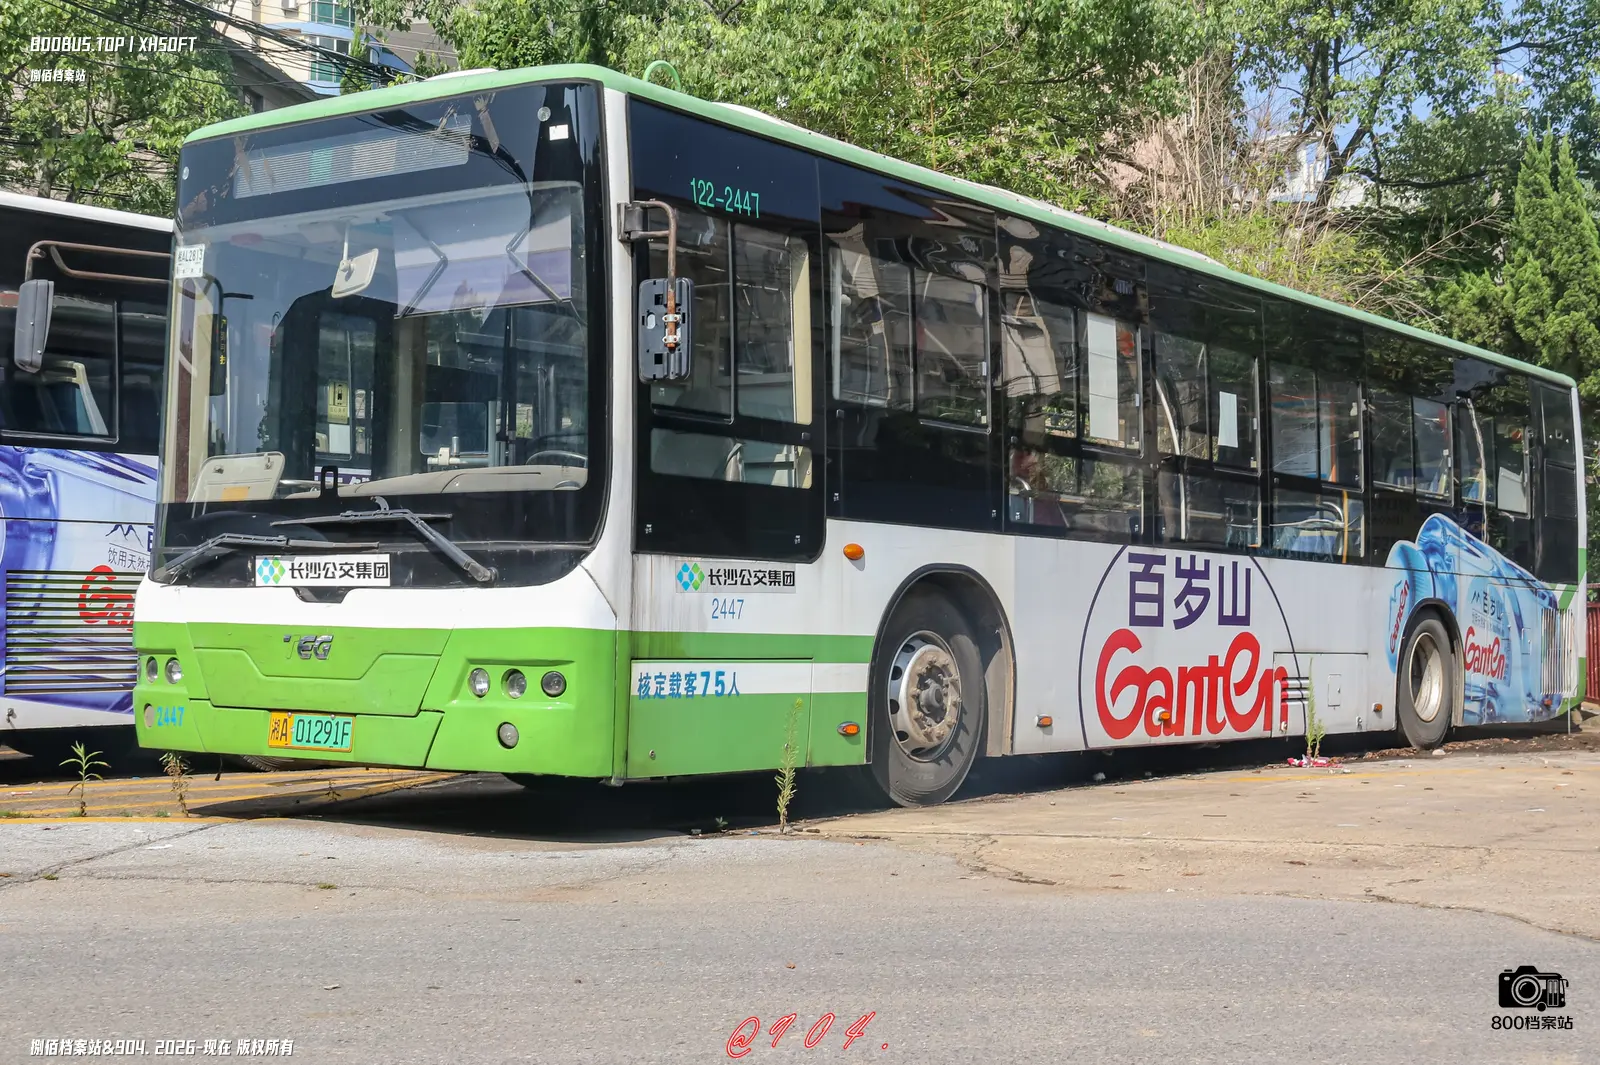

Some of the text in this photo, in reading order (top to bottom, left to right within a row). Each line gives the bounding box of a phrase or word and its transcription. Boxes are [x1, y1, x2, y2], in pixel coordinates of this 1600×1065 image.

[690, 177, 760, 219] 122-2447
[288, 561, 389, 580] 长沙公交集团
[708, 568, 796, 587] 长沙公交集团
[1128, 552, 1251, 630] 百岁山
[711, 598, 745, 620] 2447
[283, 634, 334, 661] EG
[1464, 625, 1506, 681] Ganten
[637, 670, 741, 701] 核定载客75人
[1095, 628, 1289, 740] Ganten
[157, 706, 185, 727] 2447
